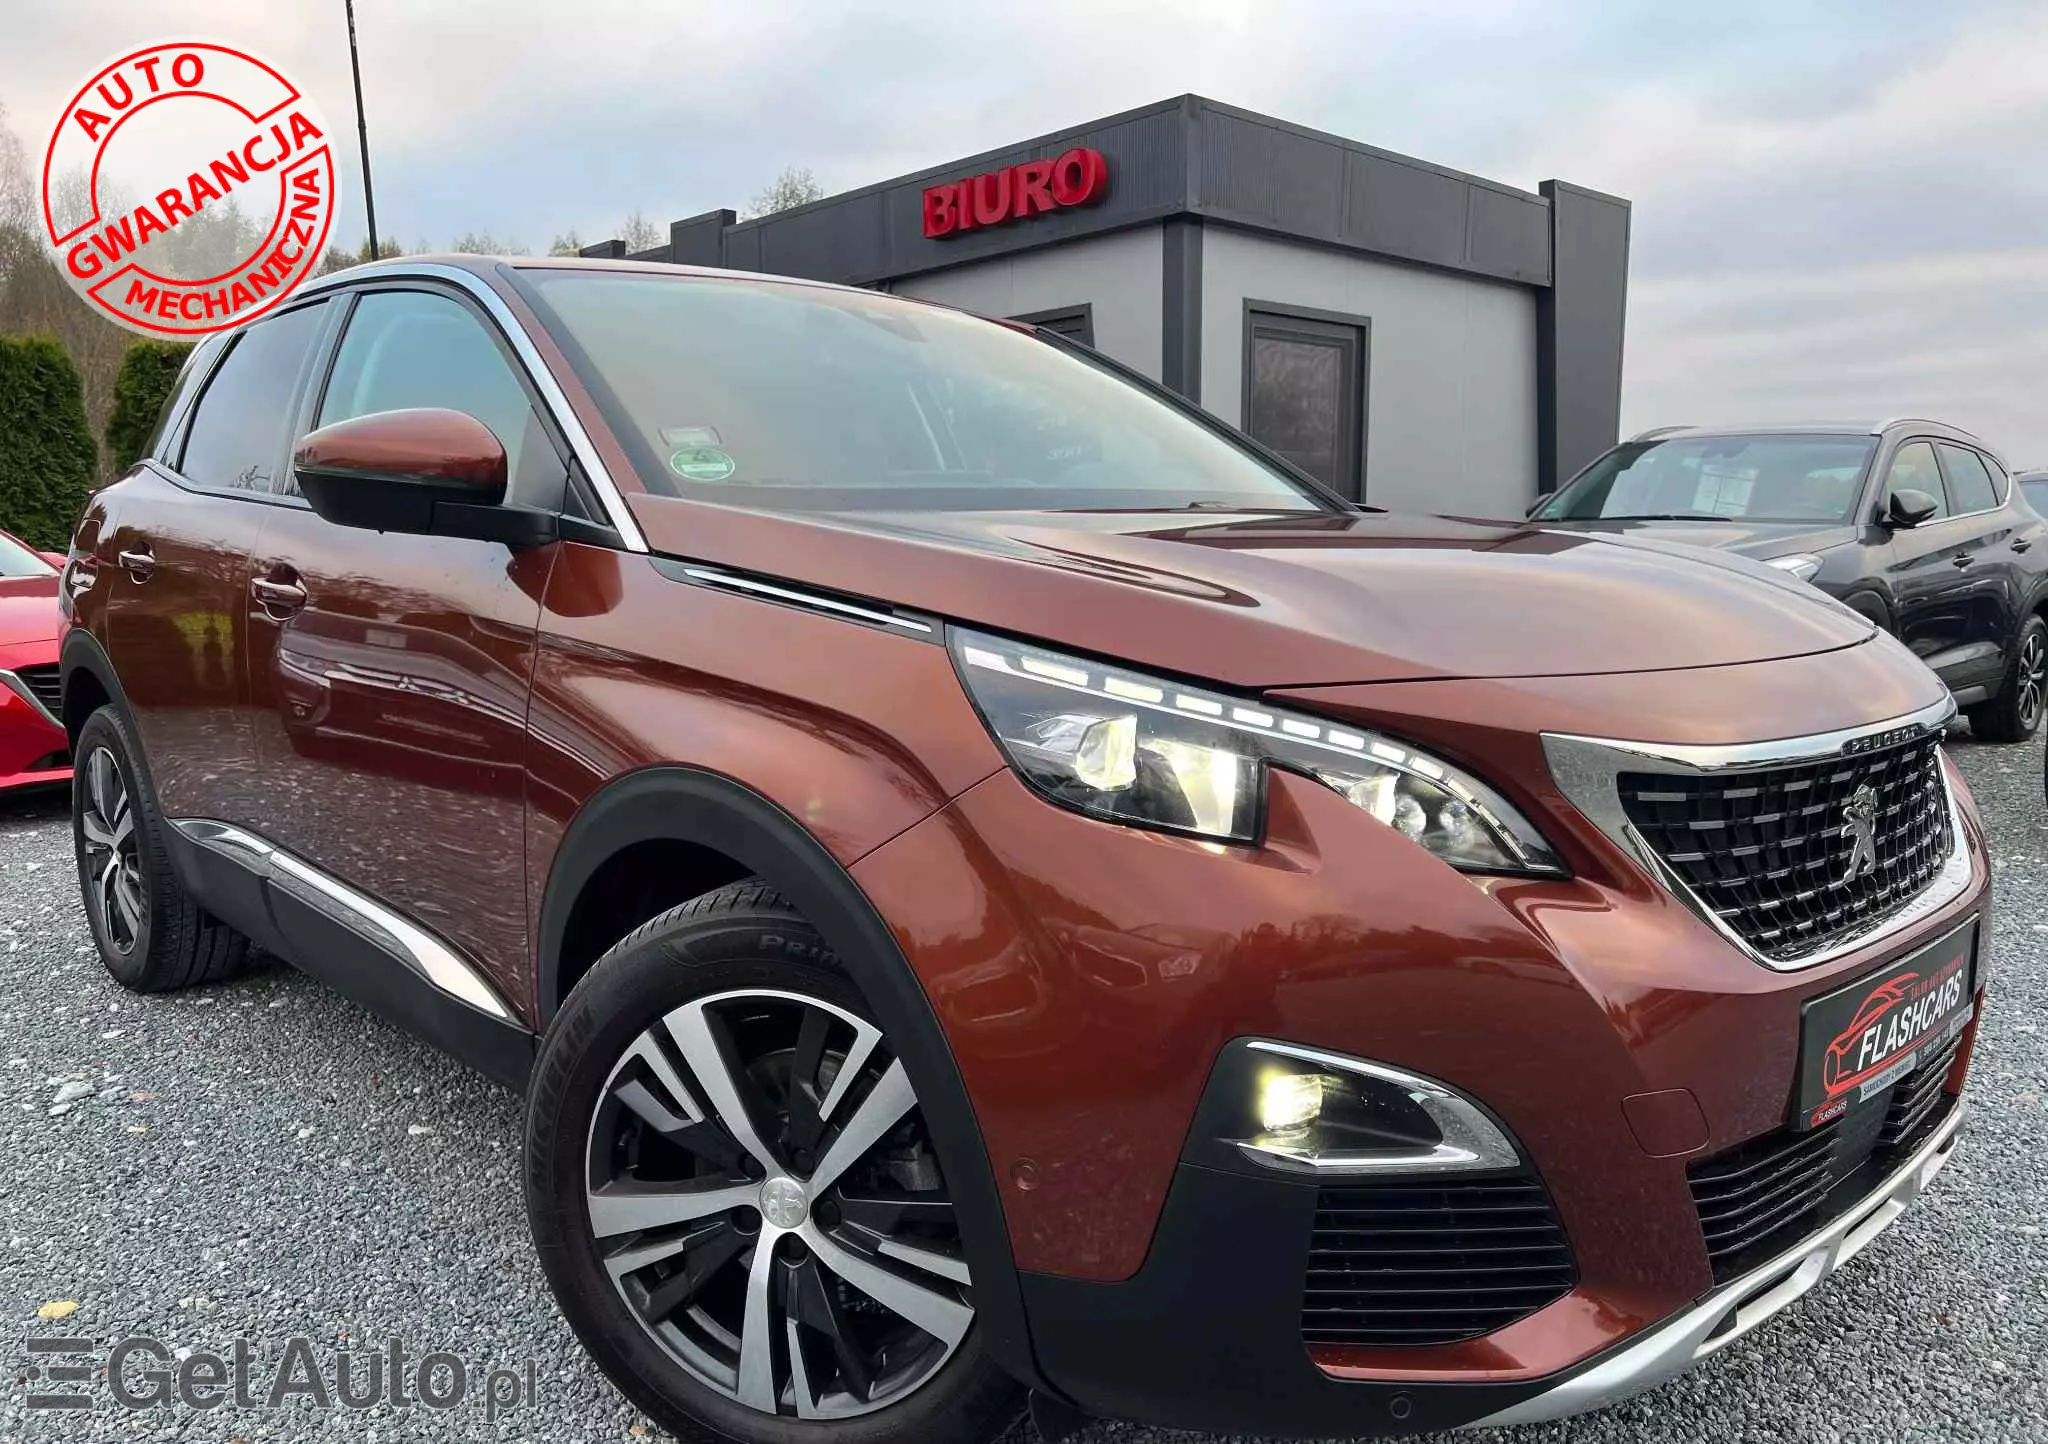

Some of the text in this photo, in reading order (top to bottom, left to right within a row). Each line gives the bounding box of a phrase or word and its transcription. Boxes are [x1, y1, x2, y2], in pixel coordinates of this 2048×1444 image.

[922, 147, 1107, 240] BIURO
[1851, 725, 1919, 752] PEUGEOT
[1857, 968, 1963, 1072] FLASHCARS
[1818, 1100, 1848, 1121] FLASHCARS
